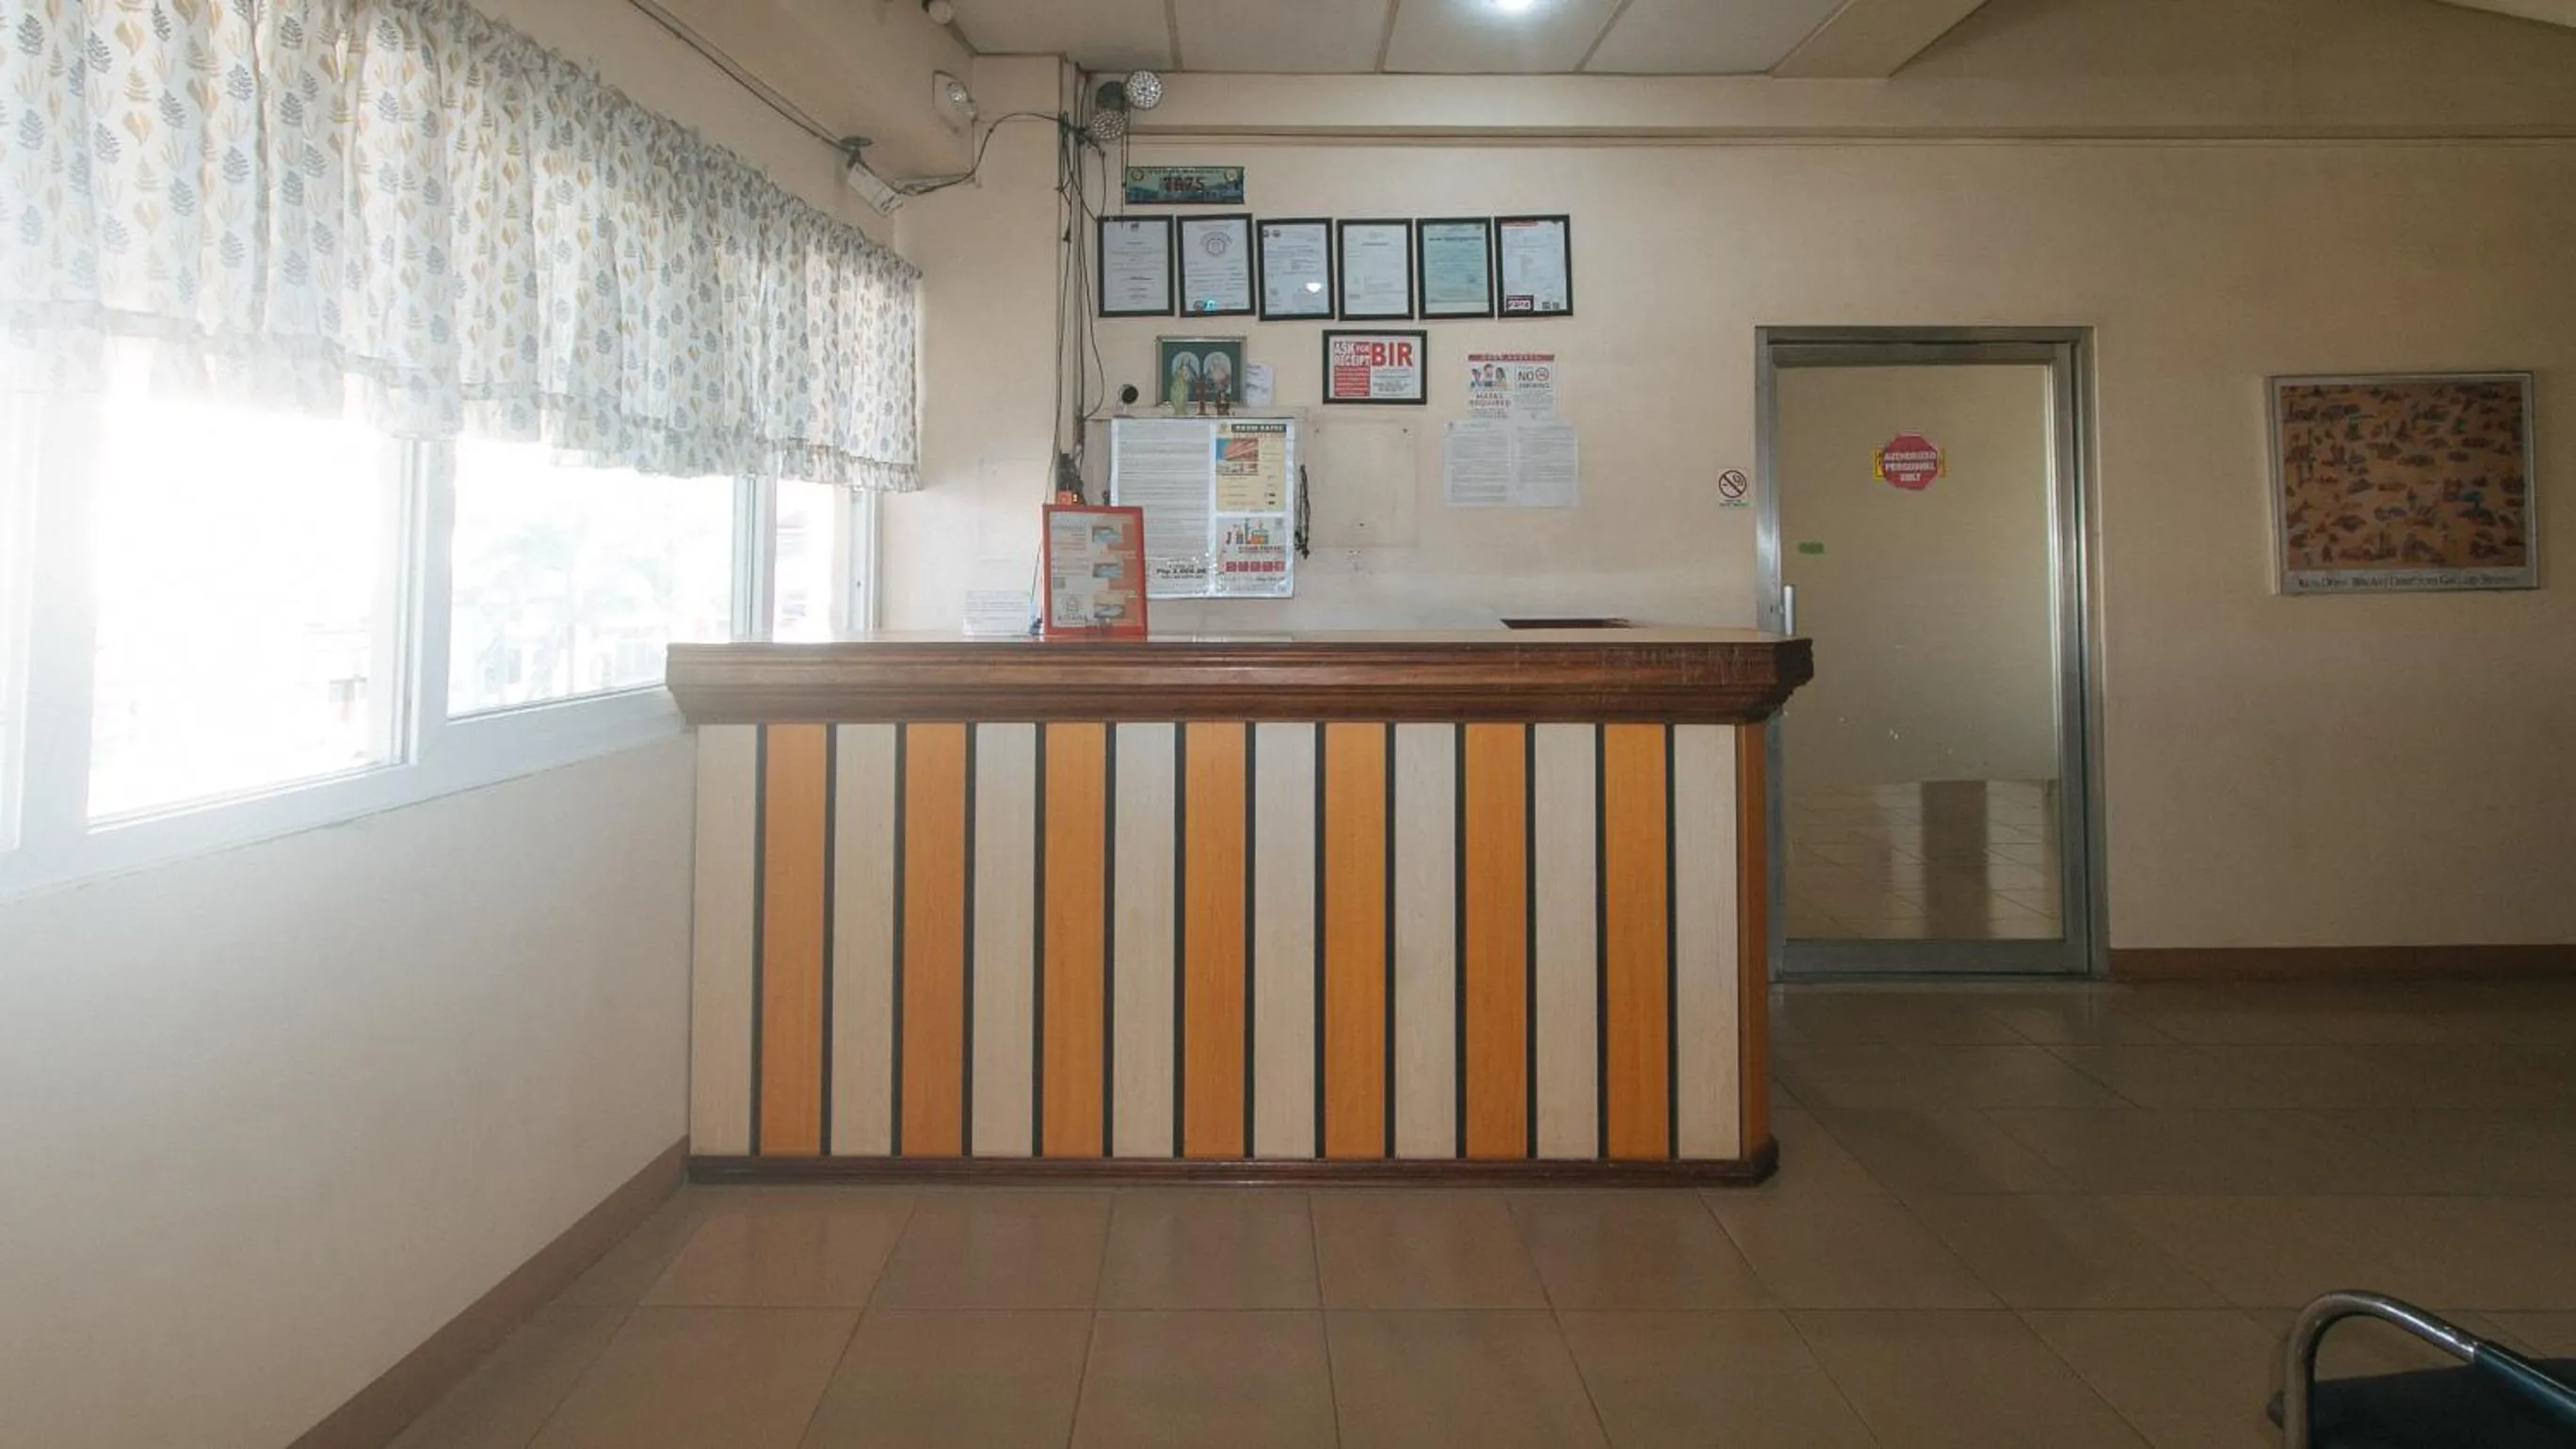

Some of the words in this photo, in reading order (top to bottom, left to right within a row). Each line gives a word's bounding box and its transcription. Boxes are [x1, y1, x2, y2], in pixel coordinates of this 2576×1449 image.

[1334, 342, 1353, 352] ASK
[1372, 342, 1413, 366] BIR
[1334, 354, 1370, 365] RECEIPT
[1518, 370, 1534, 380] NO
